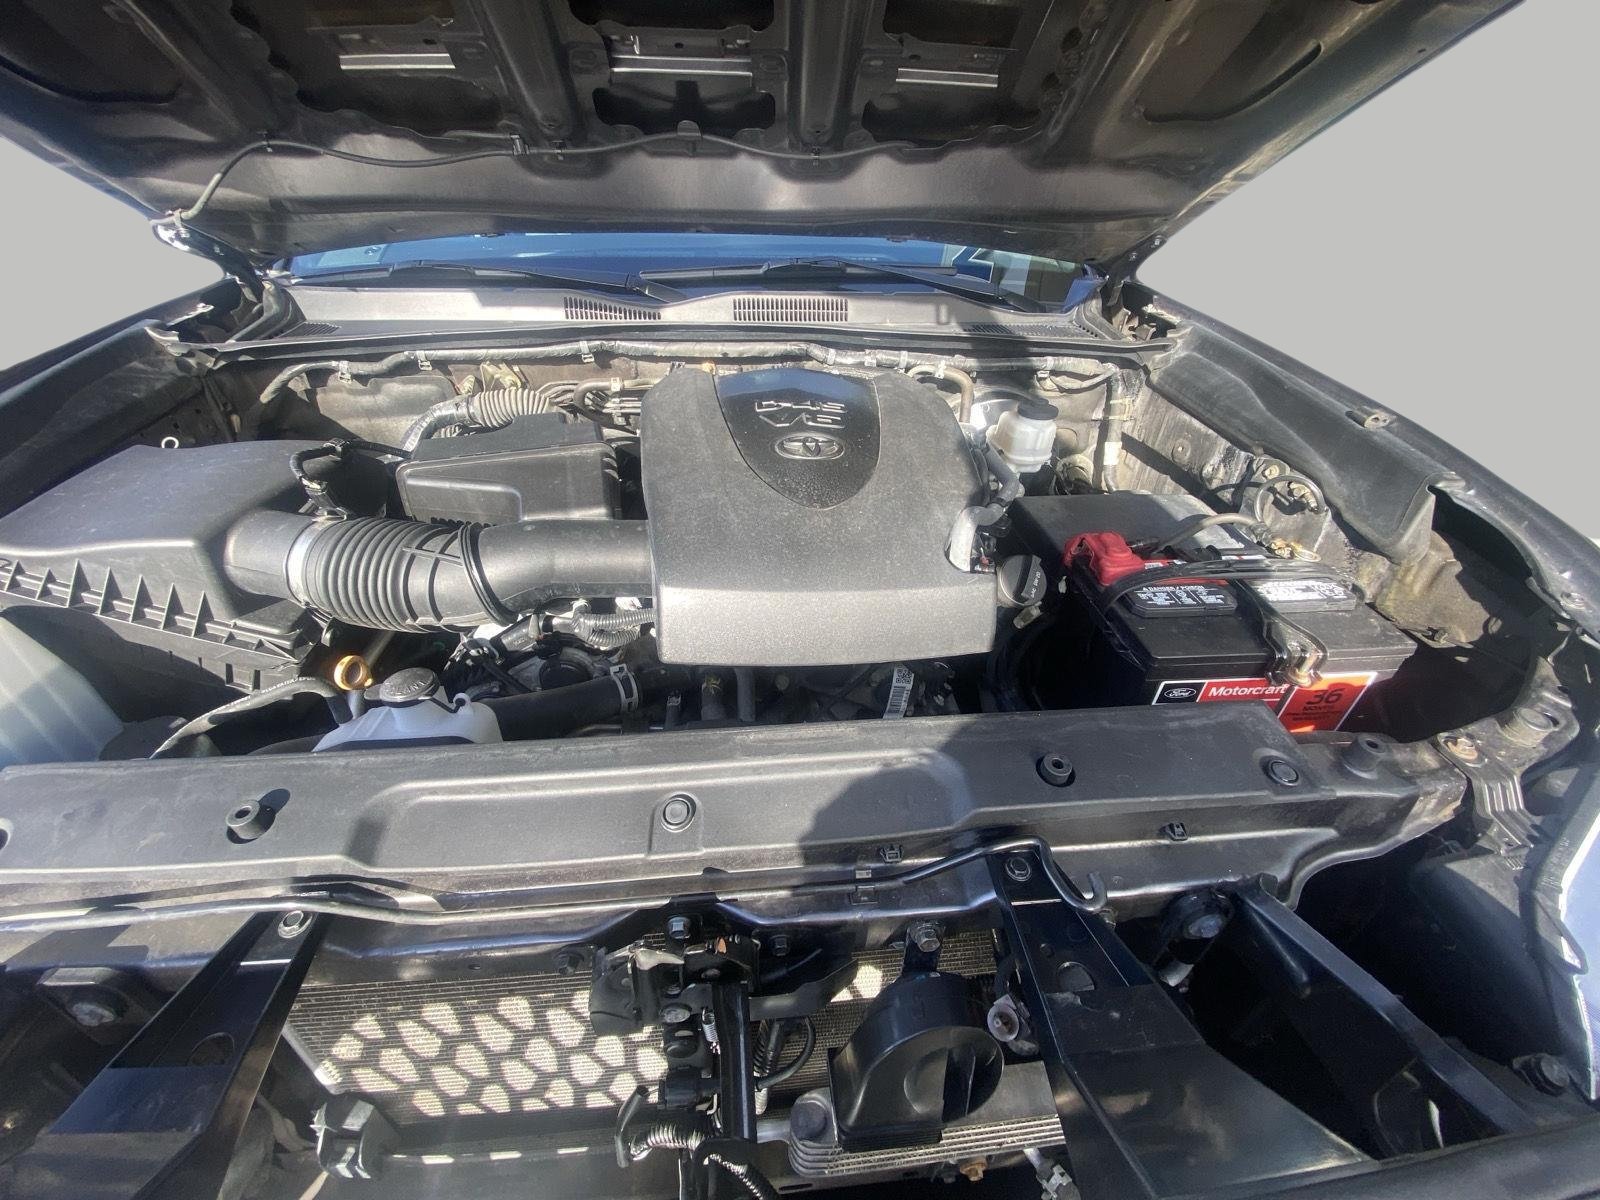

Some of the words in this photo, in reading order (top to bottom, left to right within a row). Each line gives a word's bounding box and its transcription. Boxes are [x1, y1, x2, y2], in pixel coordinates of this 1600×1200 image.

[758, 411, 846, 429] V6
[1168, 688, 1192, 698] Ford
[1305, 687, 1346, 705] 36
